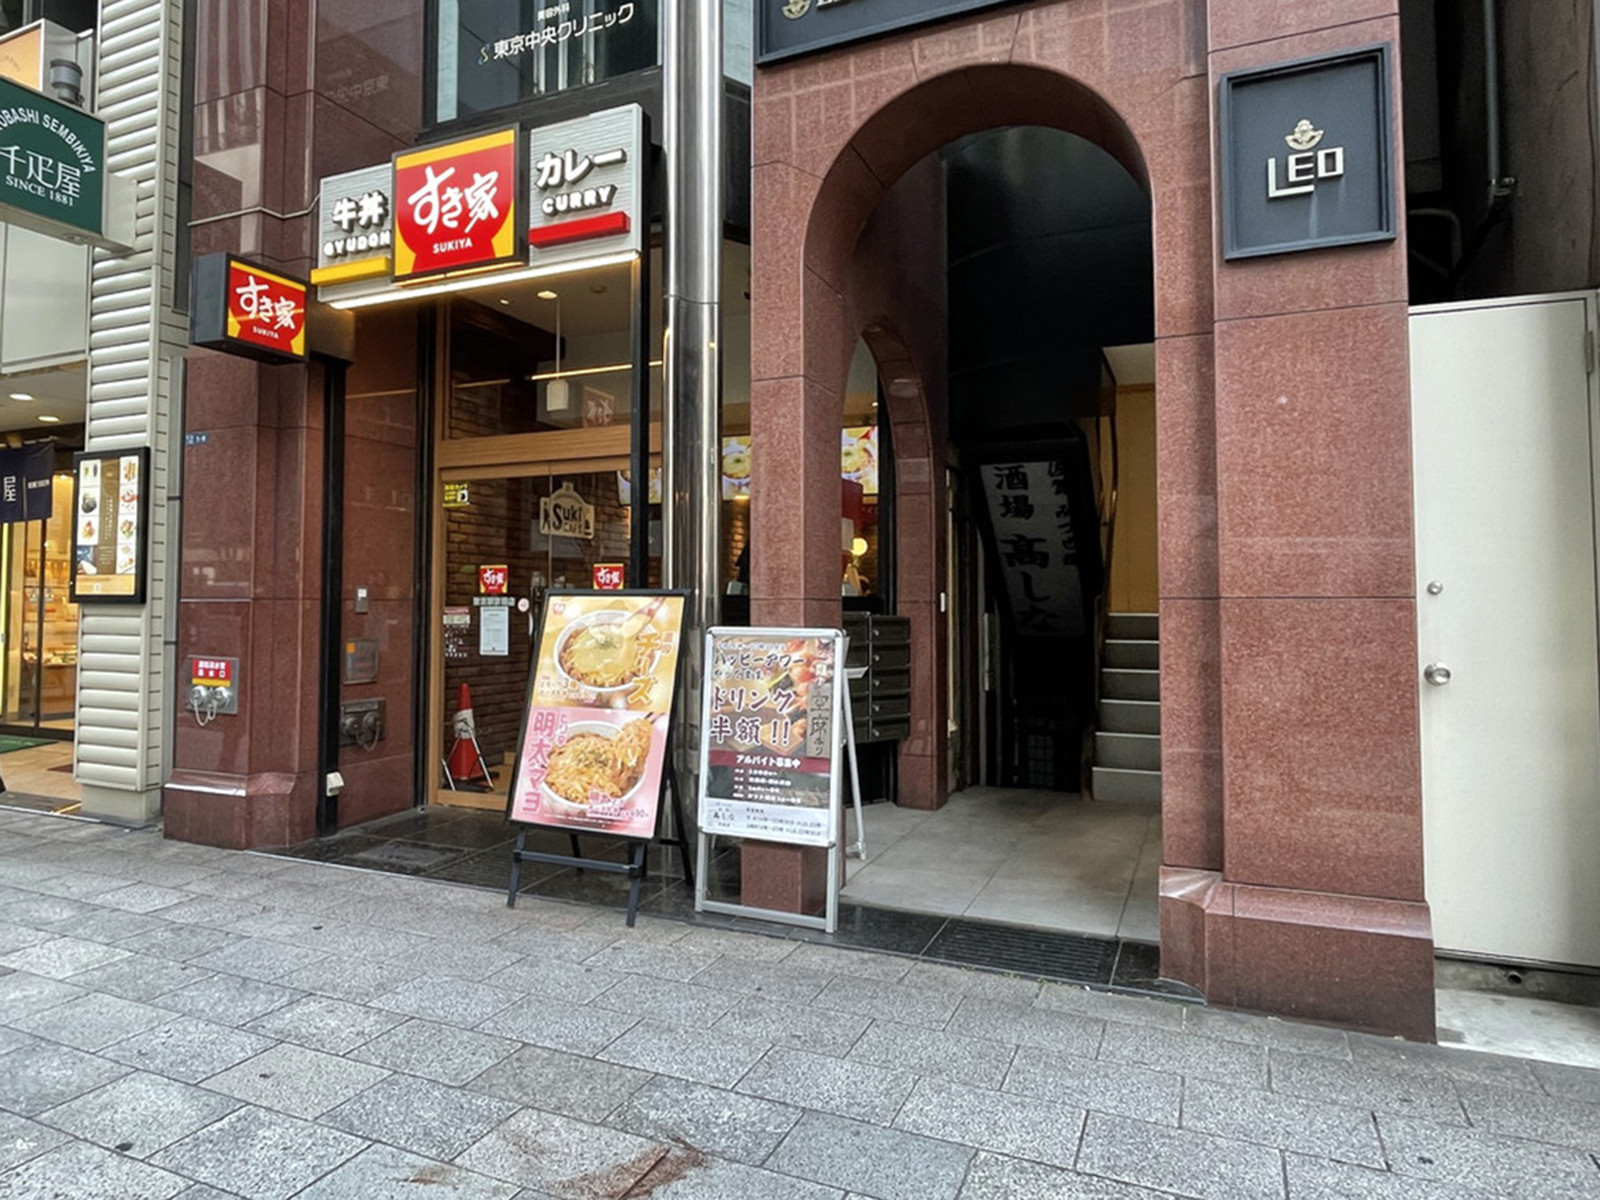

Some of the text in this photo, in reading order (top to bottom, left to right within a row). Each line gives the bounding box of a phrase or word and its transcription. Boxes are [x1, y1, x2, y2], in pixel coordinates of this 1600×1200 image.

[493, 3, 634, 60] 東京中央クリニック
[0, 107, 95, 172] OBASHI SEMBIKIYA
[0, 145, 80, 198] 千疋屋
[6, 175, 46, 197] SINCE
[535, 148, 626, 188] カレー
[1268, 147, 1344, 200] LEO
[333, 191, 388, 231] 牛丼
[408, 166, 499, 234] すき家
[542, 184, 617, 215] CURRY
[324, 230, 391, 257] GYUDON
[433, 238, 472, 254] SUKIYA
[236, 274, 296, 331] すき家
[253, 326, 279, 340] SUKIYA
[994, 465, 1034, 520] 酒場
[627, 633, 661, 705] チーズ
[714, 686, 794, 713] ドリンク
[710, 716, 760, 744] 半額
[522, 711, 556, 813] 明太マヨ
